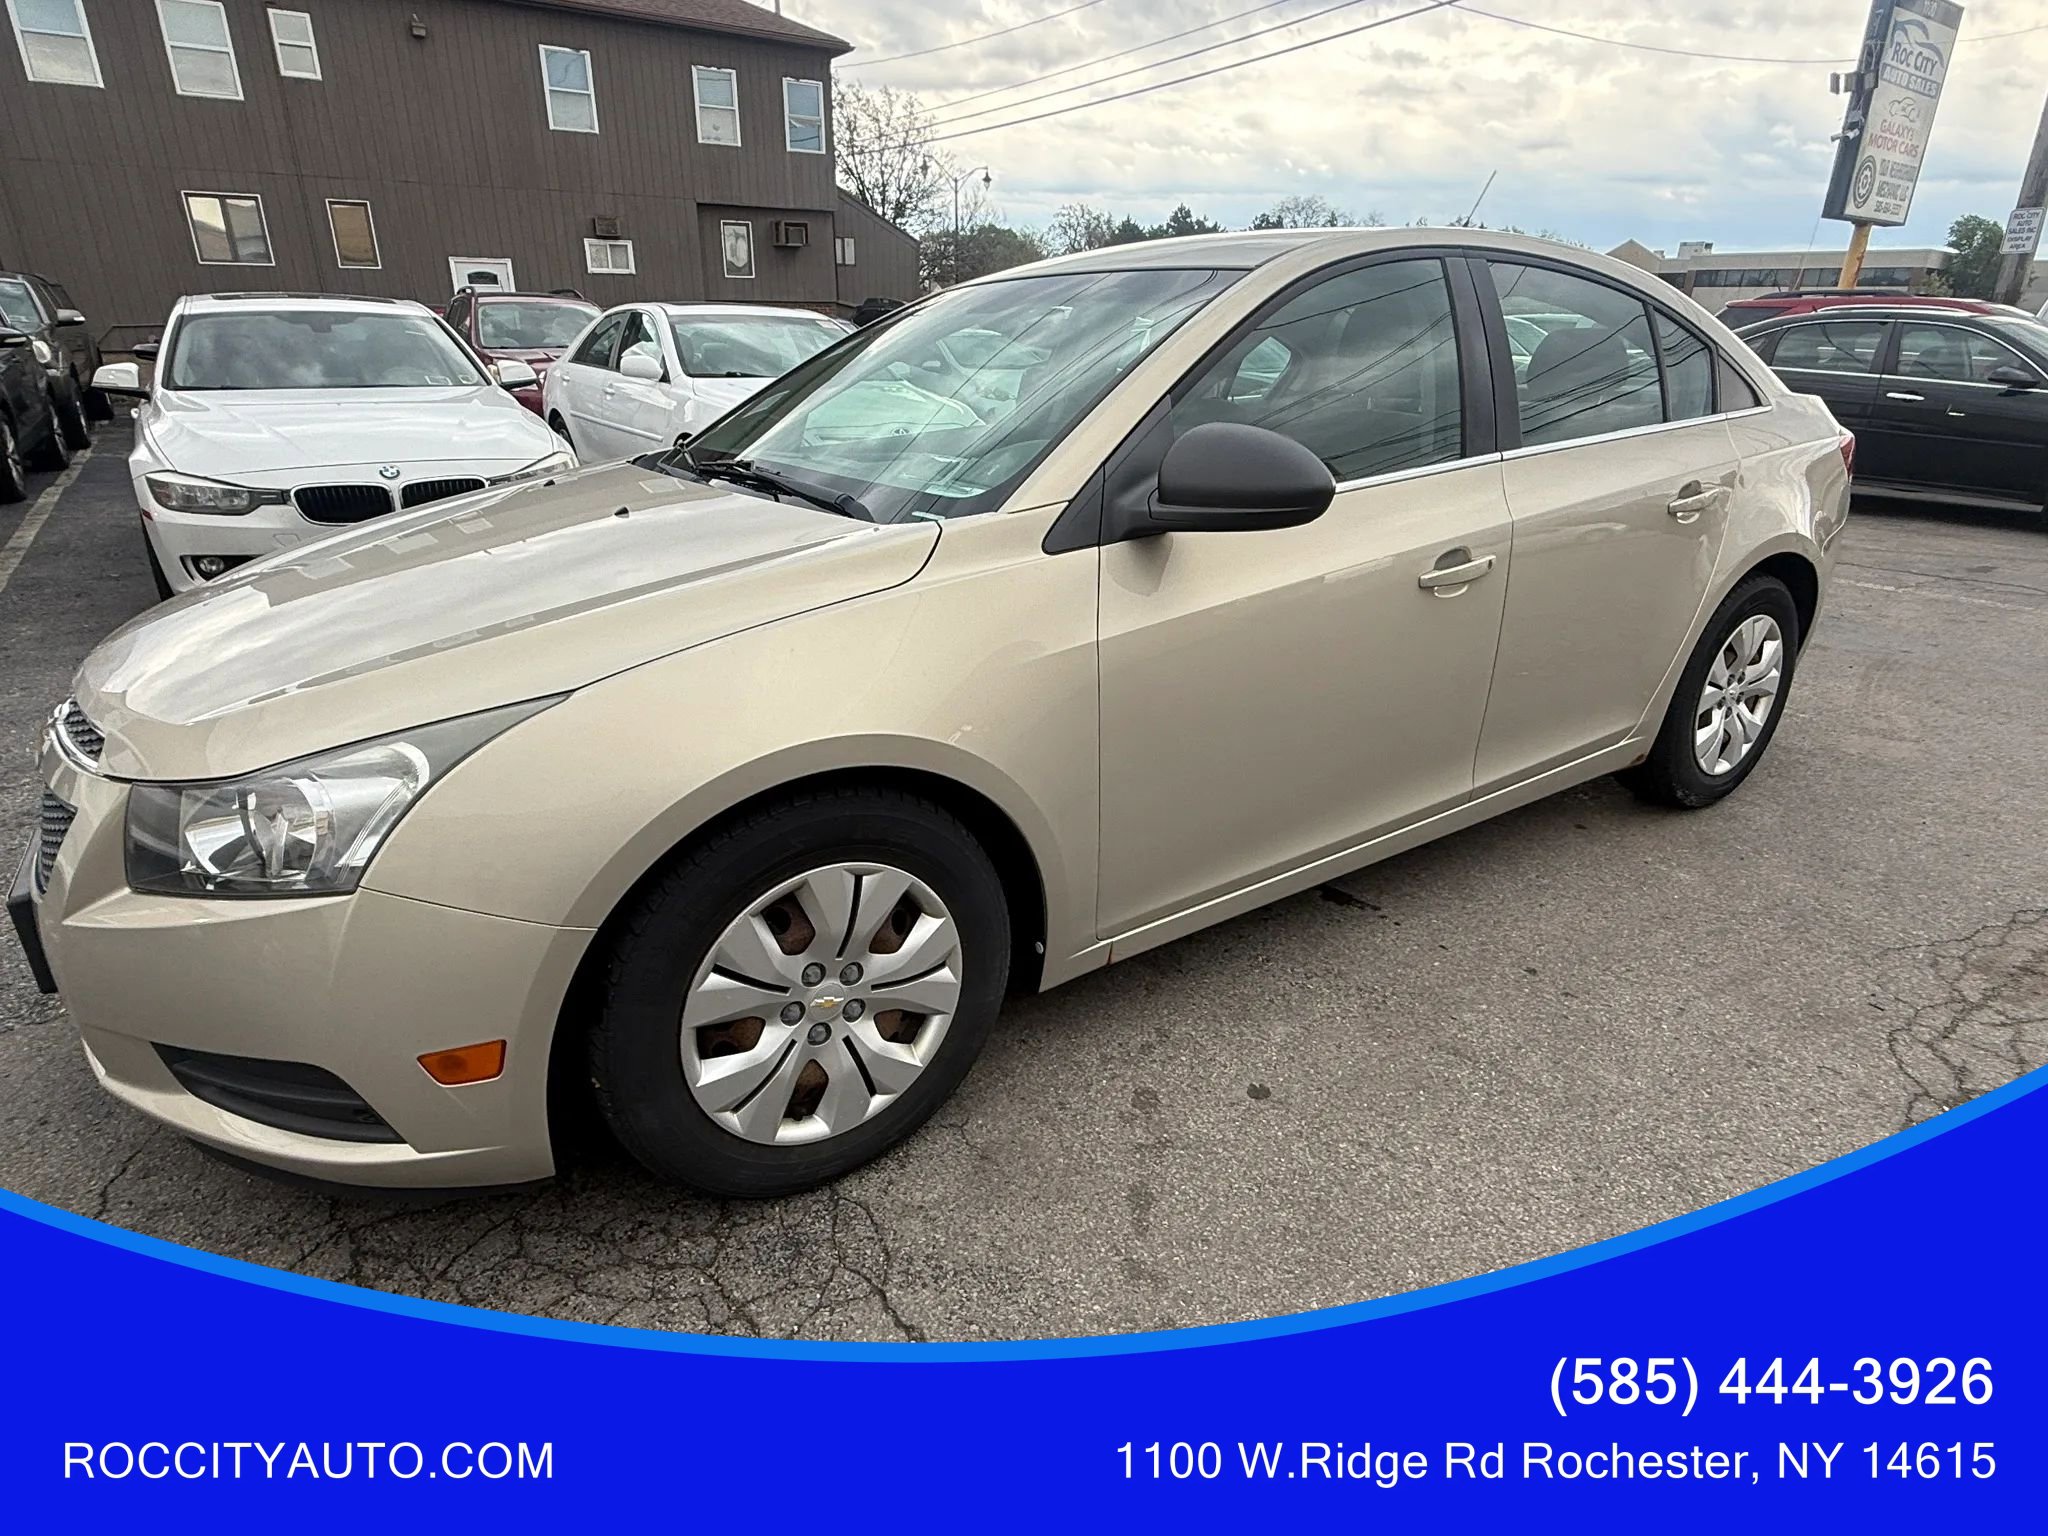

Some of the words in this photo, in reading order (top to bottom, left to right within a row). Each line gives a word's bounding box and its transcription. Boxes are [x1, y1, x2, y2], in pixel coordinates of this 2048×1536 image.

[1891, 41, 1913, 67] ROC
[1914, 50, 1938, 76] CITY
[1883, 67, 1909, 87] AUTO
[1909, 75, 1938, 97] SALES
[1868, 132, 1898, 153] MOTOR
[1898, 140, 1920, 158] CARS
[2008, 227, 2025, 235] SALES
